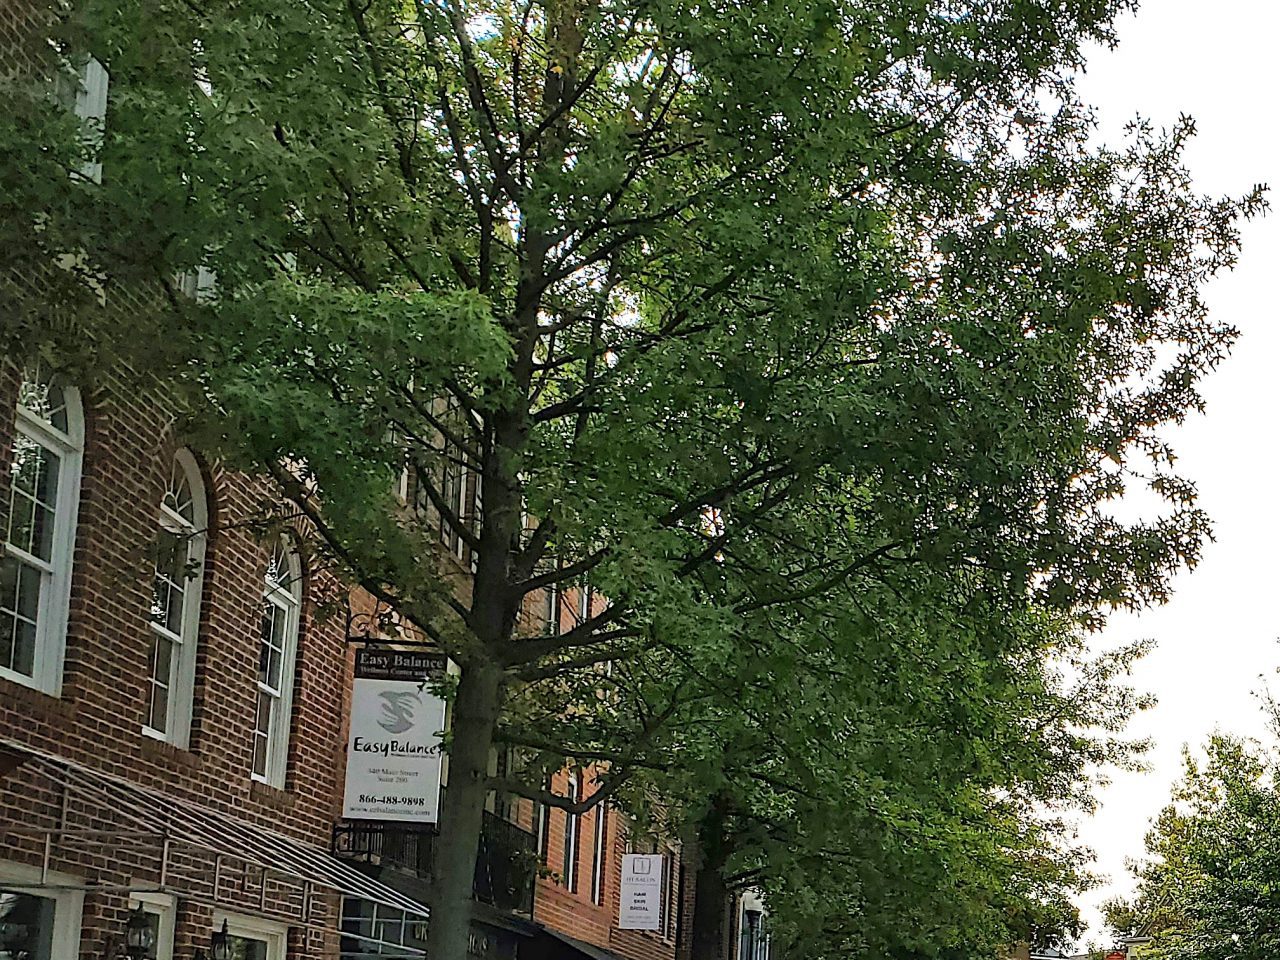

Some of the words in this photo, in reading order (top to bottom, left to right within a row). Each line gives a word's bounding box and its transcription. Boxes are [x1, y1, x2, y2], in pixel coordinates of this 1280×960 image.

[360, 653, 389, 668] Easy
[394, 654, 444, 669] Balance
[359, 793, 425, 806] 866-488-9898
